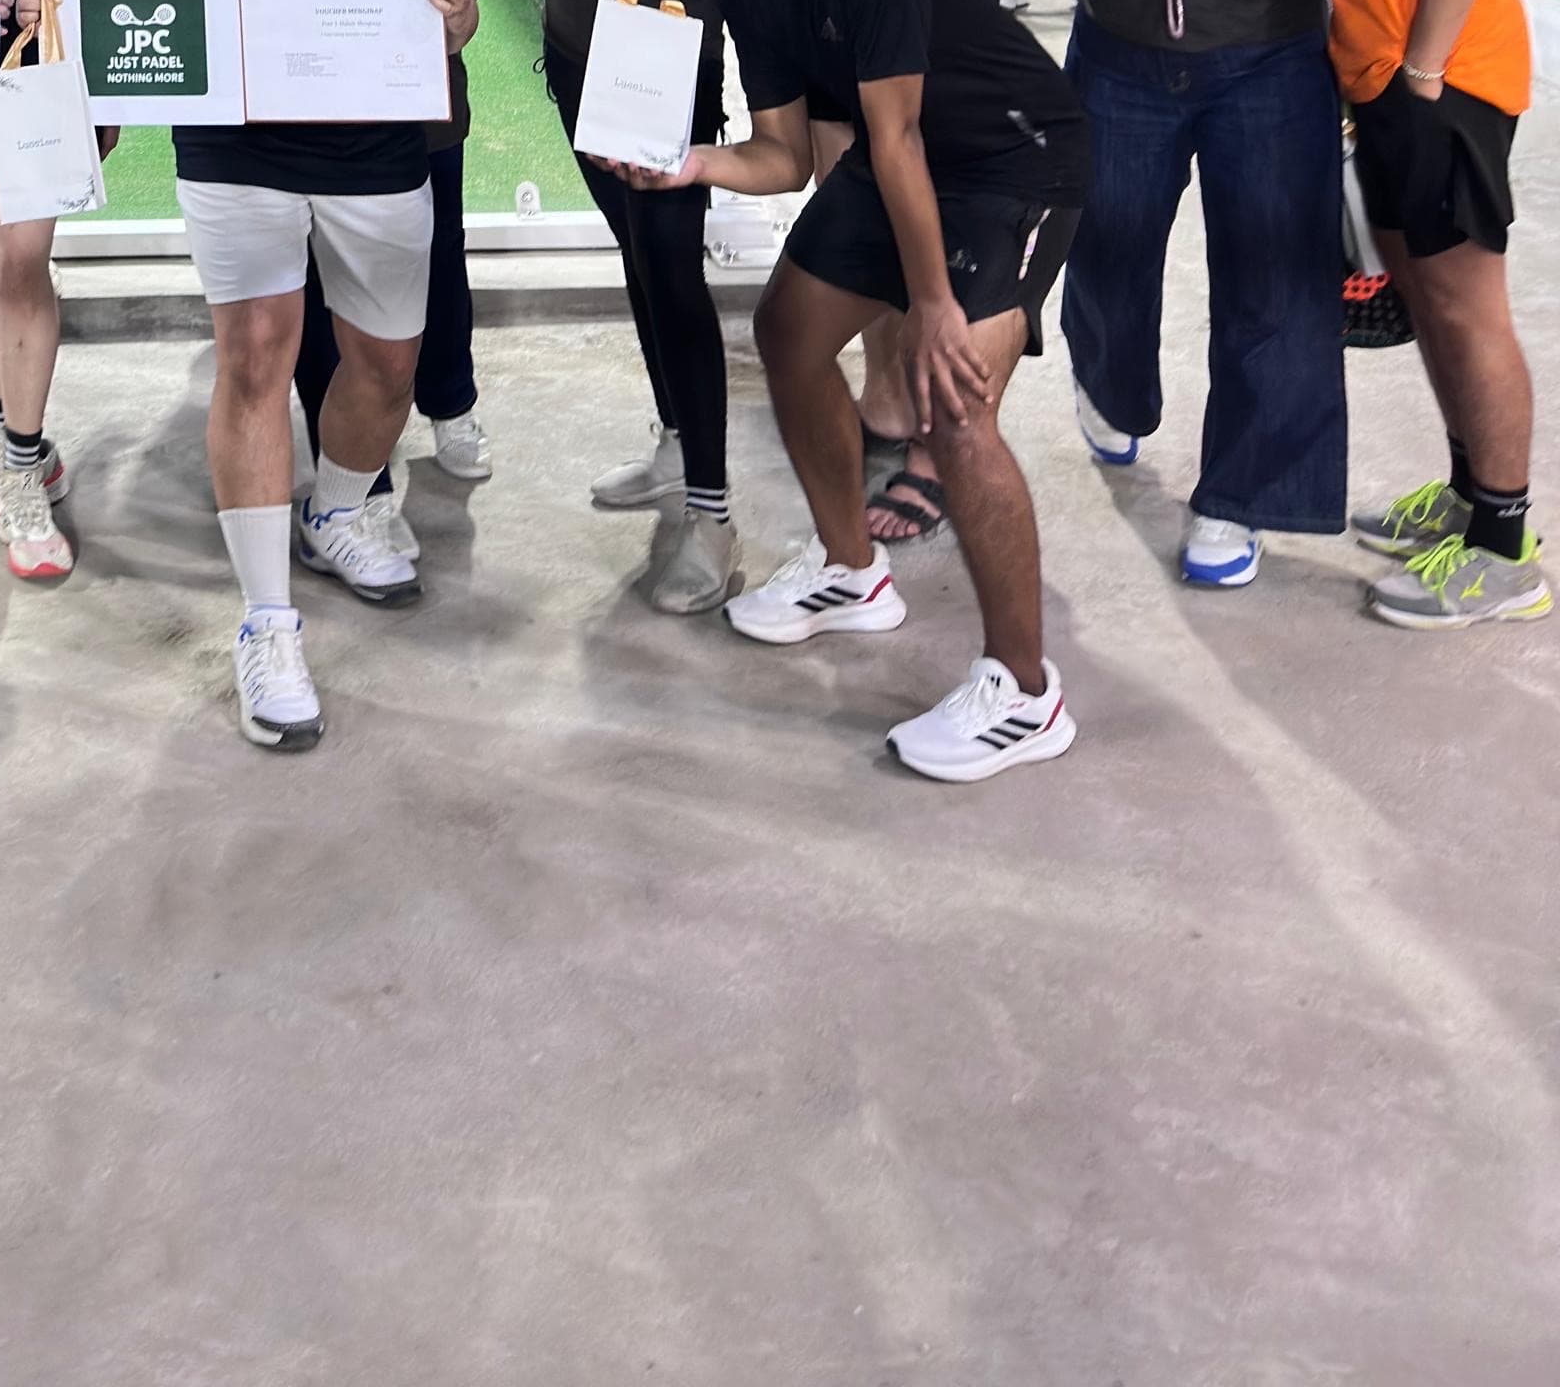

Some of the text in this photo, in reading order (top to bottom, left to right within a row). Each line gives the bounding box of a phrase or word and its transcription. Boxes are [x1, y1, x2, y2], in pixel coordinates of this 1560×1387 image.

[117, 29, 171, 54] JPC
[107, 55, 184, 70] JUST PADEL
[107, 72, 184, 84] NOTHING MORE
